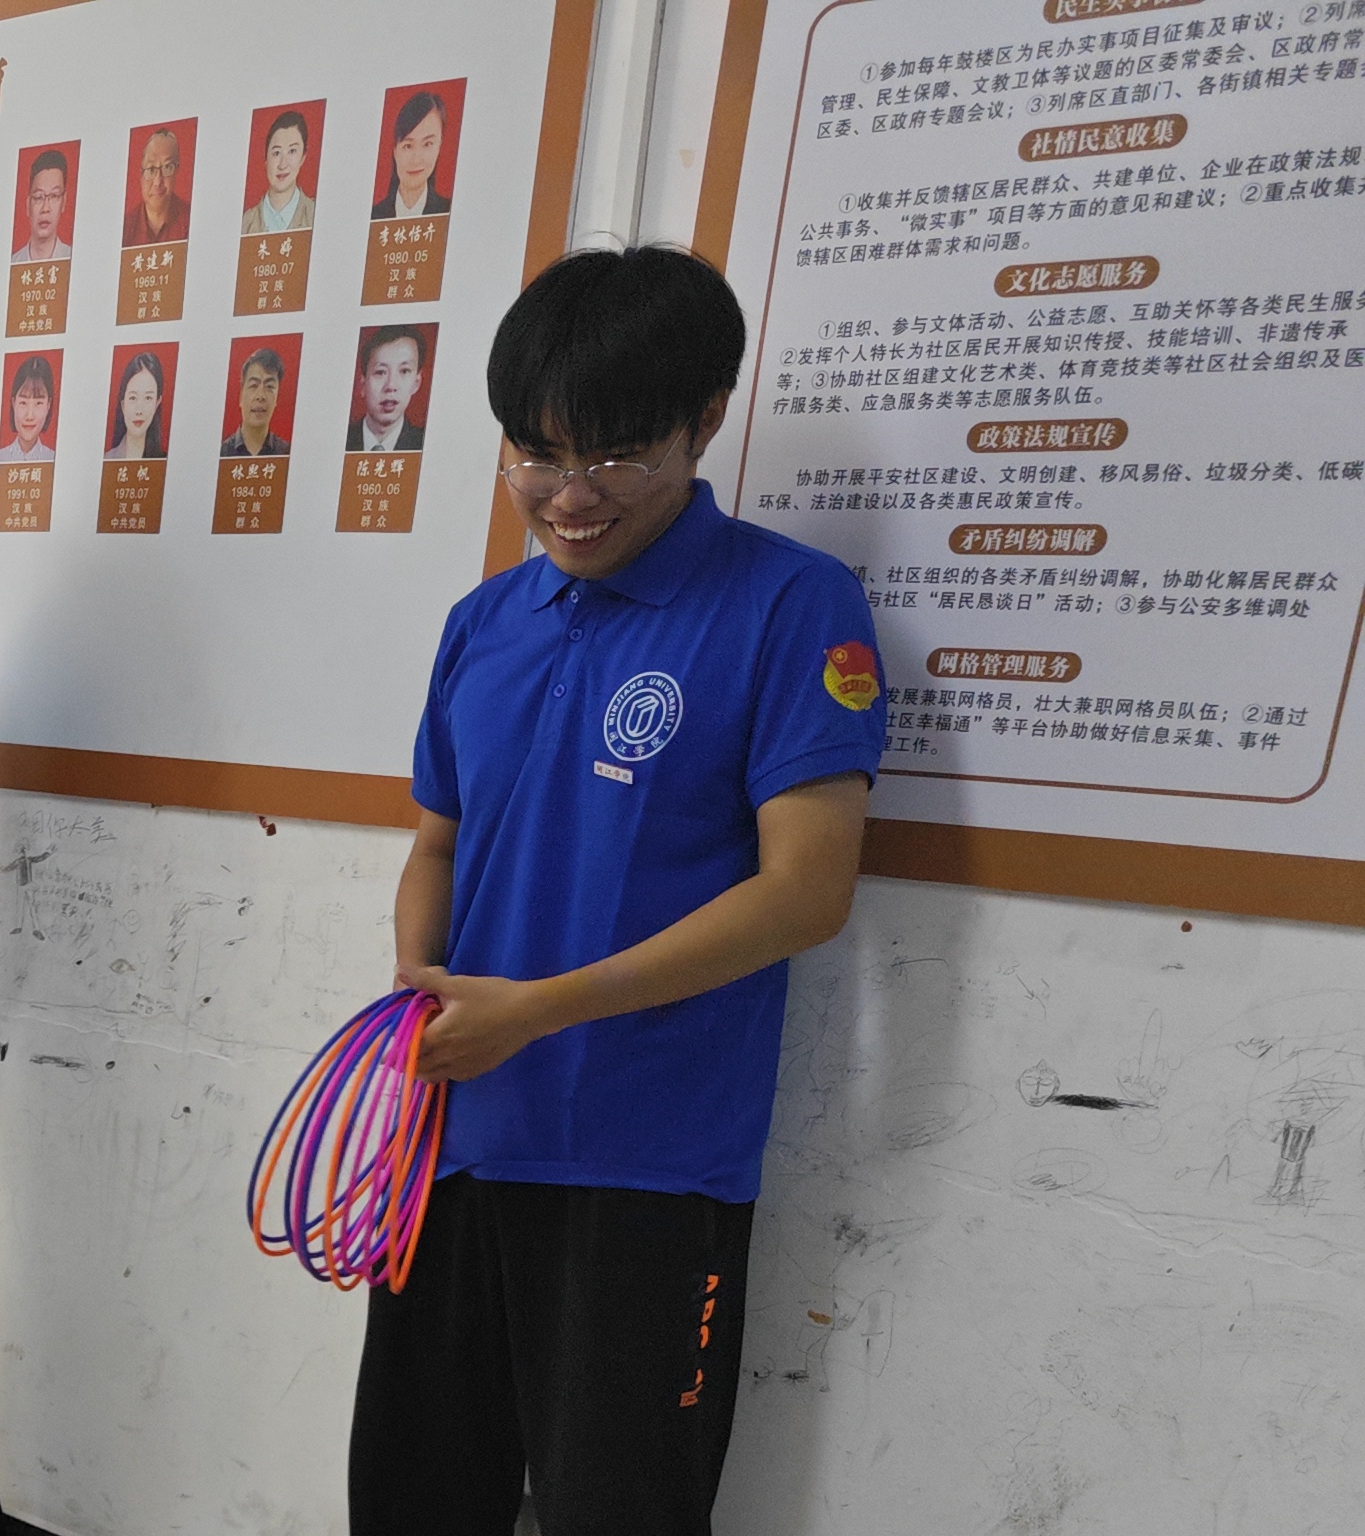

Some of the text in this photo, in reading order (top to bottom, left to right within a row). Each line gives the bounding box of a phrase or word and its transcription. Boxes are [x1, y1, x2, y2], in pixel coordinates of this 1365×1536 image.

[1030, 119, 1175, 159] 社情民意收集
[795, 232, 1030, 267] 馈辖区困难群体需求和问题。
[253, 262, 294, 277] 1980.07
[389, 267, 417, 282] 汉族
[1005, 261, 1148, 293] 文化志愿服务
[259, 279, 284, 293] 汉族
[387, 284, 414, 299] 群众
[138, 290, 162, 304] 汉族
[257, 295, 282, 309] 群众
[27, 304, 48, 317] 汉族
[137, 306, 161, 320] 群众
[19, 318, 53, 332] 中共党员
[977, 423, 1117, 449] 政策法规宣传
[7, 488, 41, 500] 1991.03
[114, 488, 149, 500] 1978.07
[231, 486, 271, 498] 1984.09
[356, 483, 400, 495] 1960.06
[236, 501, 261, 513] 汉族
[362, 499, 389, 512] 汉族
[757, 489, 1085, 512] 环保、法治建设以及各类惠民政策宣传。
[11, 503, 32, 514] 汉族
[118, 502, 141, 514] 汉族
[4, 517, 38, 528] 中共党员
[110, 517, 146, 529] 中共党员
[235, 517, 260, 529] 群众
[360, 515, 387, 528] 群众
[959, 528, 1097, 552] 矛盾纠纷调解
[937, 652, 1070, 679] 网格管理服务
[608, 678, 676, 731] MINJIANG UNIVERSITY
